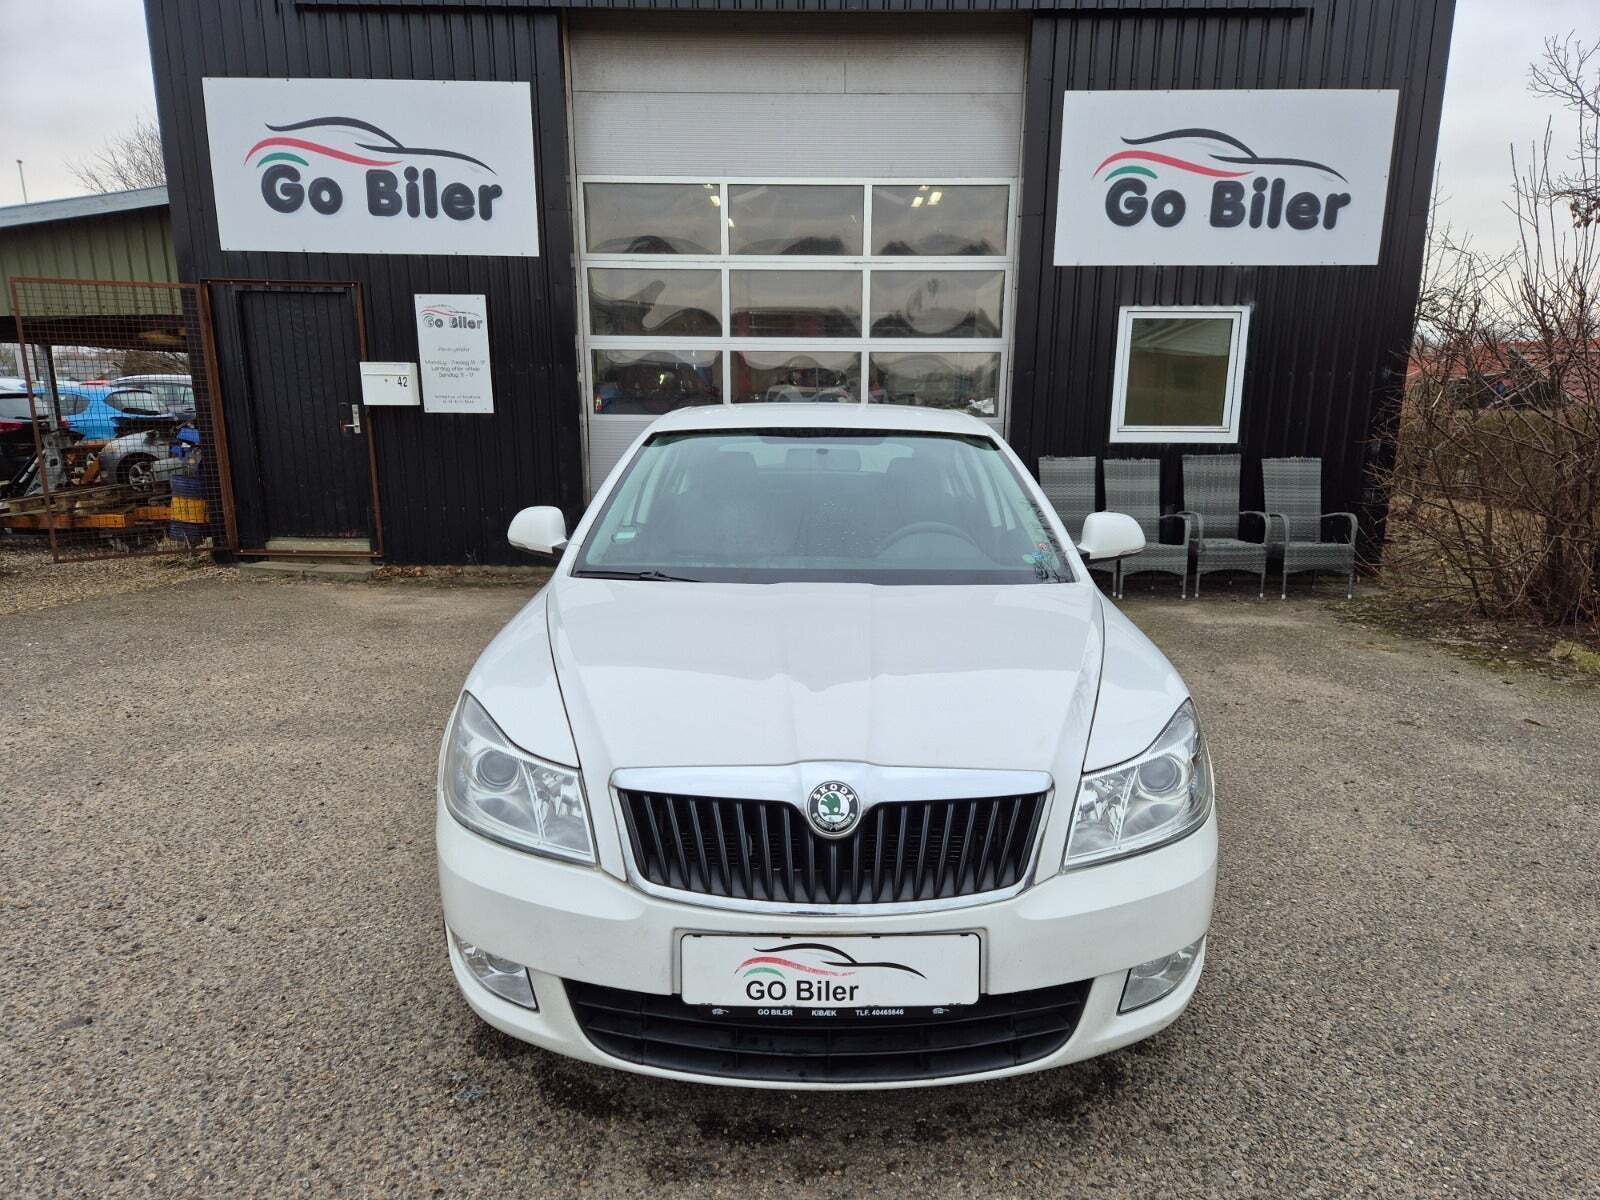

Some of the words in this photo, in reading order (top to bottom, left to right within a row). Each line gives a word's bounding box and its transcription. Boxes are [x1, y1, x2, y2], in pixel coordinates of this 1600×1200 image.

[261, 163, 343, 216] Go
[365, 165, 503, 221] Biler
[1105, 177, 1186, 228] Go
[1209, 176, 1351, 231] Biler
[423, 315, 444, 329] Go
[449, 315, 483, 330] Biler
[397, 376, 408, 388] 42
[746, 980, 787, 1001] GO
[796, 980, 859, 1001] Biler
[757, 1008, 770, 1016] GO
[770, 1008, 793, 1016] BILER
[855, 1009, 870, 1017] TLF.
